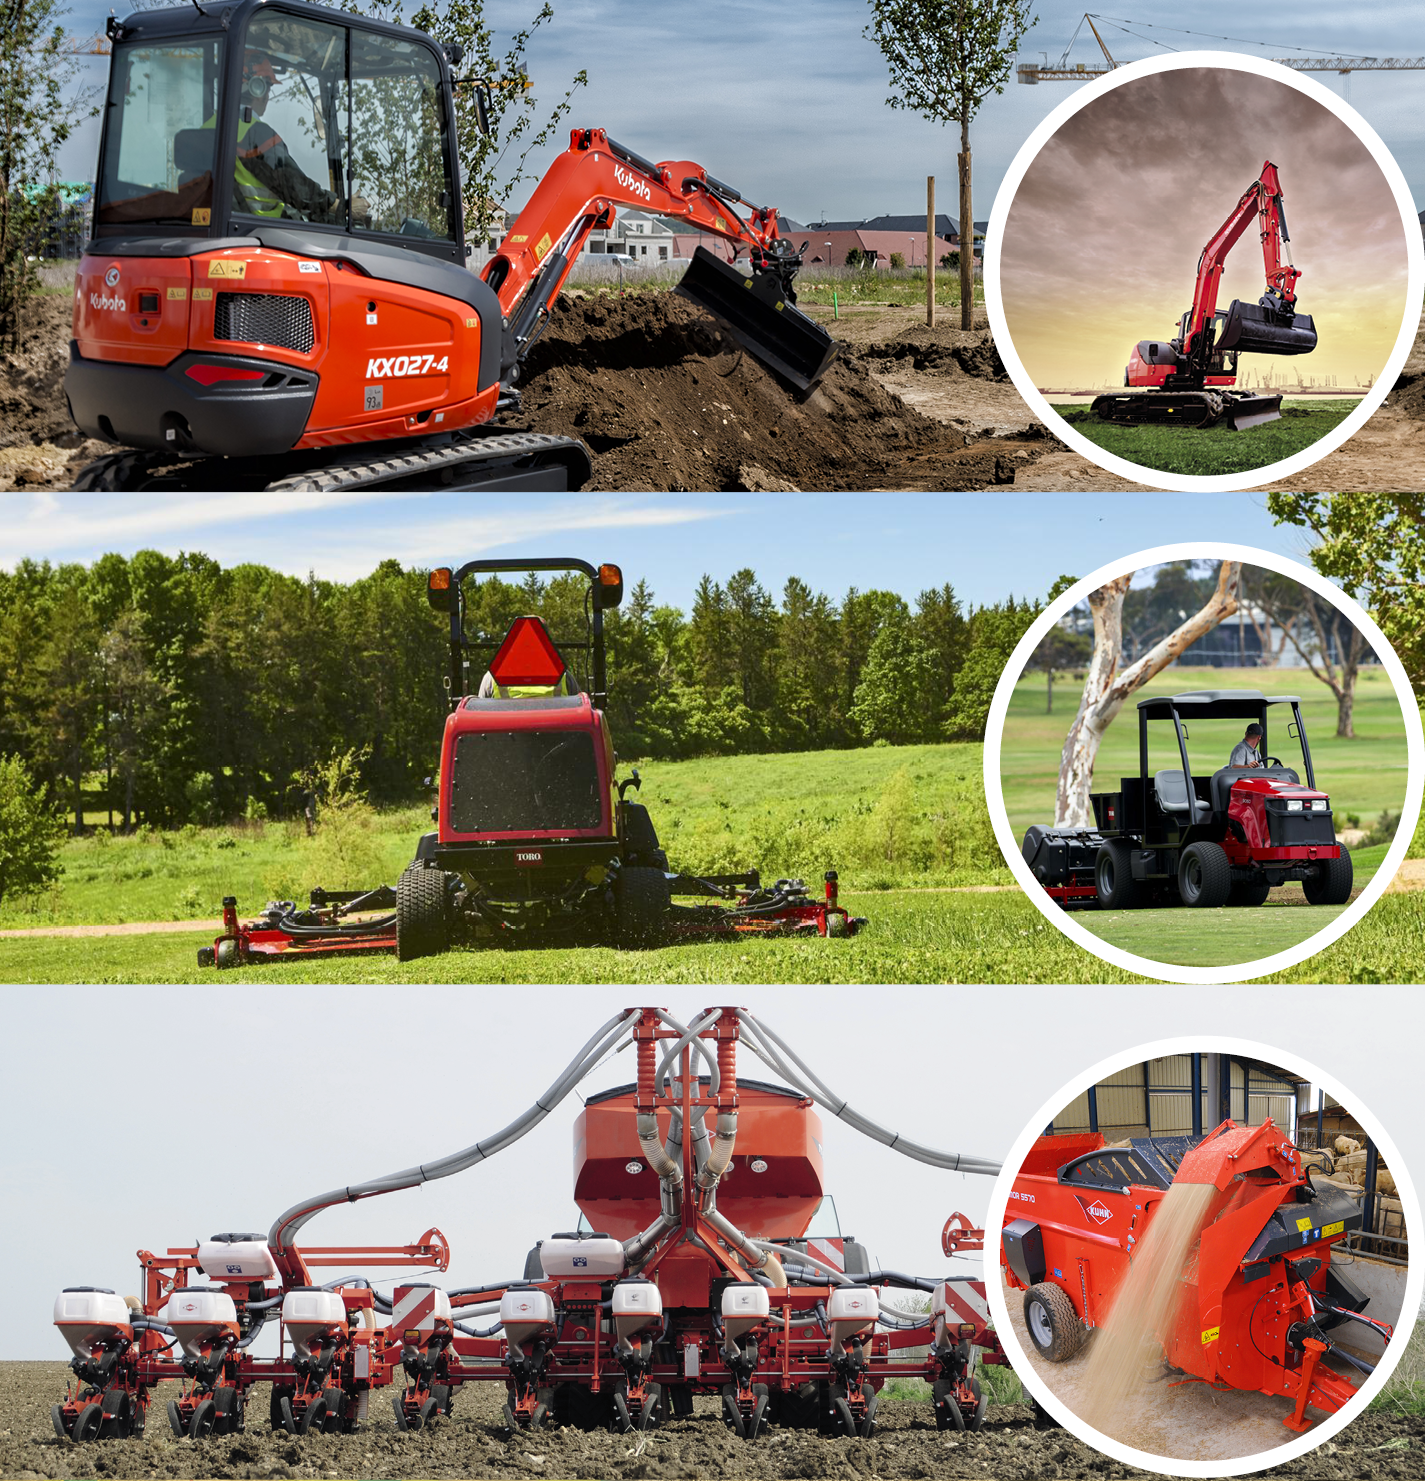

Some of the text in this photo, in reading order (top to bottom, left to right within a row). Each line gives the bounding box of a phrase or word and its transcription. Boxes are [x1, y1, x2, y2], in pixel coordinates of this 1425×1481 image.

[614, 164, 651, 202] Kubota
[90, 292, 126, 312] Kubota
[365, 354, 449, 379] KX027-4
[366, 396, 376, 409] 93
[516, 852, 542, 862] TORO
[1020, 1192, 1036, 1204] 5570
[1089, 1206, 1112, 1219] KUHN
